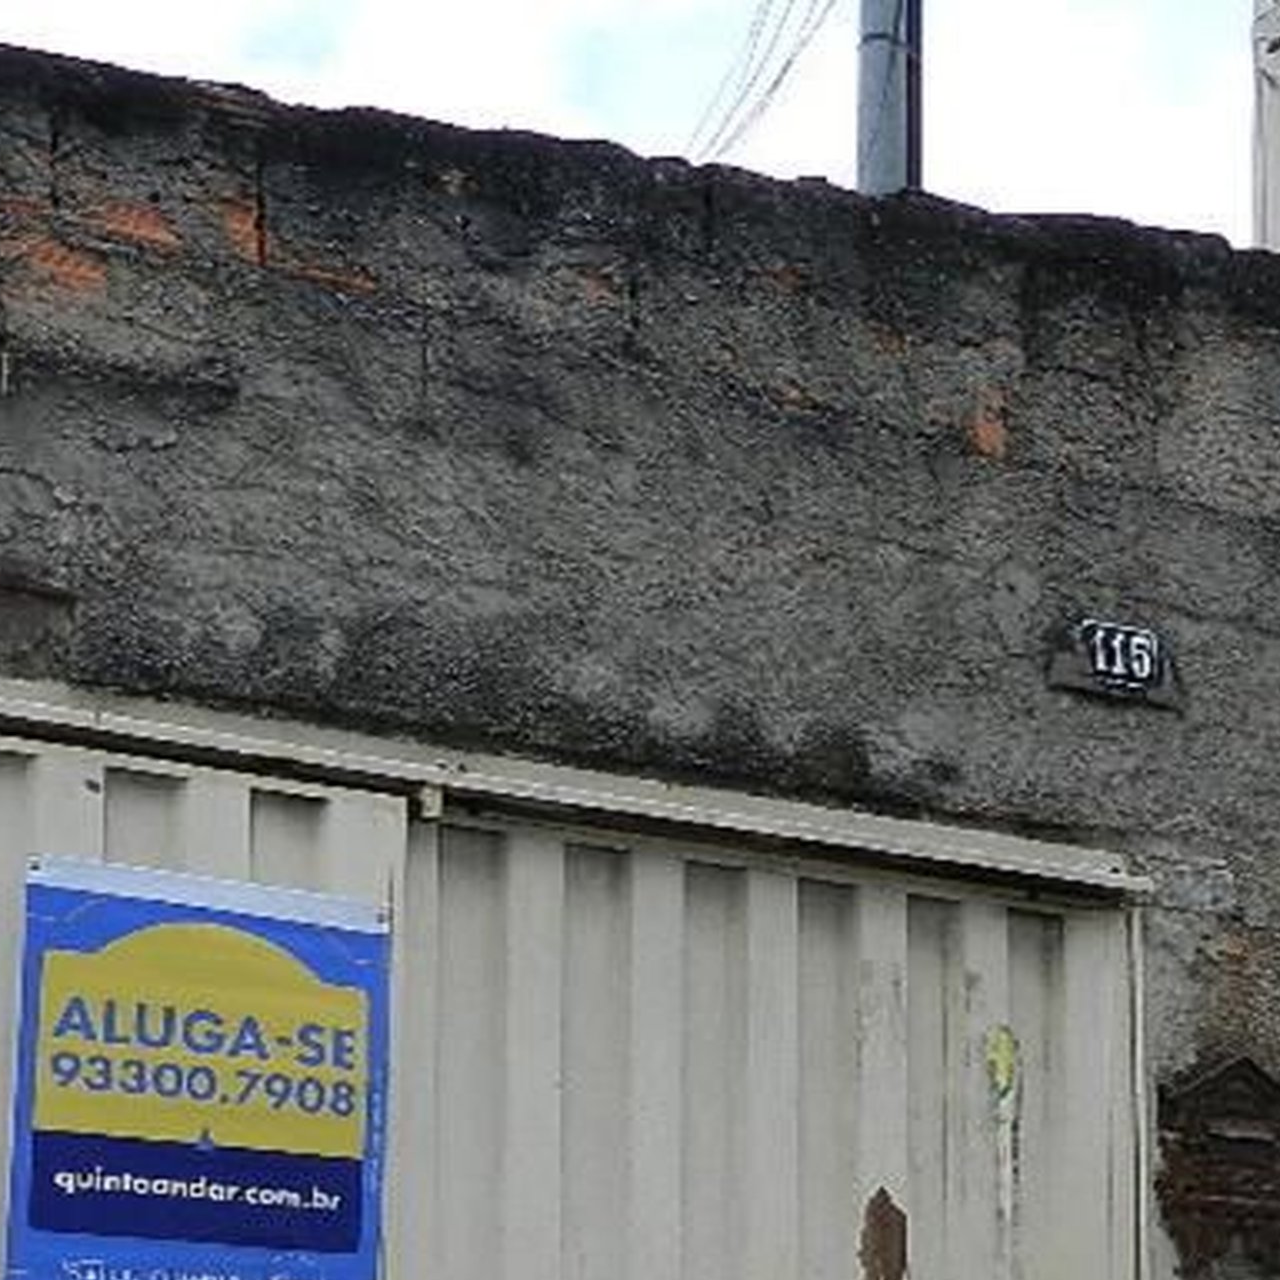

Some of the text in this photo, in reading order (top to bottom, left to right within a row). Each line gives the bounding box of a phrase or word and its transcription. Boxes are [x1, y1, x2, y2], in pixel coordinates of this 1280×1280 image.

[1091, 629, 1151, 678] 115
[51, 996, 356, 1071] ALUGA-SE
[50, 1052, 357, 1118] 93300.7908
[53, 1165, 342, 1210] quintoandar.com.br
